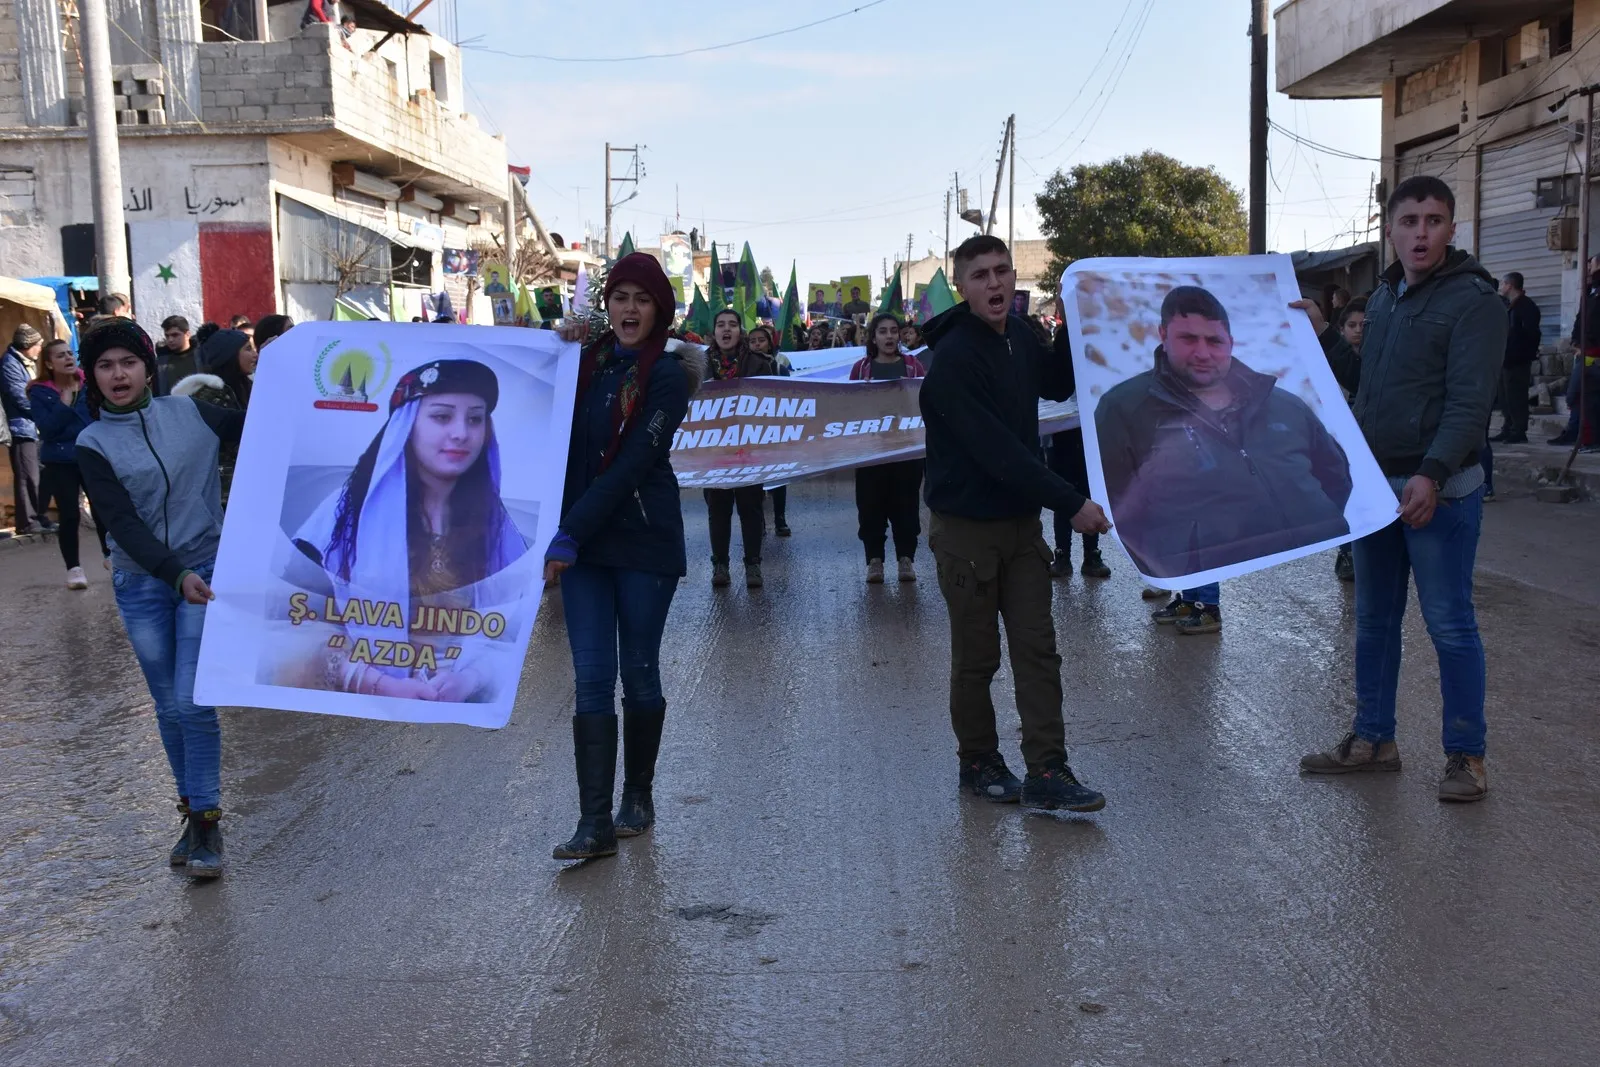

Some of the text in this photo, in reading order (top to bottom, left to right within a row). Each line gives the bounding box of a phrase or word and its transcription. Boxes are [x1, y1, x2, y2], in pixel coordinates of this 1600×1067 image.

[824, 416, 895, 437] SERÎ
[899, 416, 925, 430] H
[288, 592, 507, 639] Ş. LAVA JINDO
